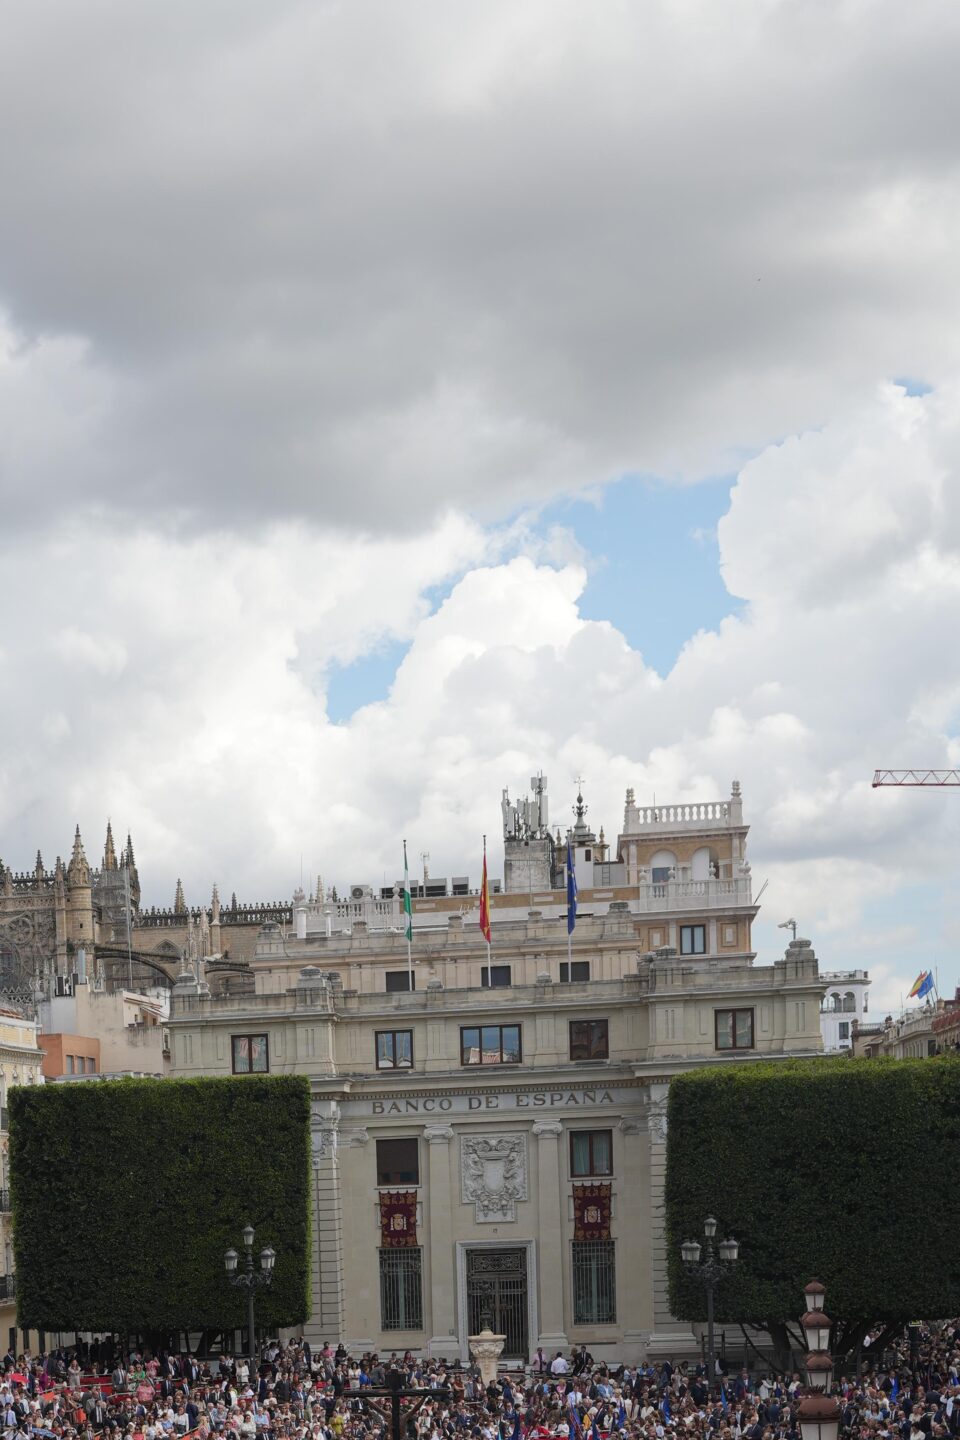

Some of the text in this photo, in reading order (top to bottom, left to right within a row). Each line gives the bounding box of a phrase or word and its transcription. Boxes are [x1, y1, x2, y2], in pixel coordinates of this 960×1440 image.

[371, 1090, 615, 1115] BANCO DE ESPAÑA
